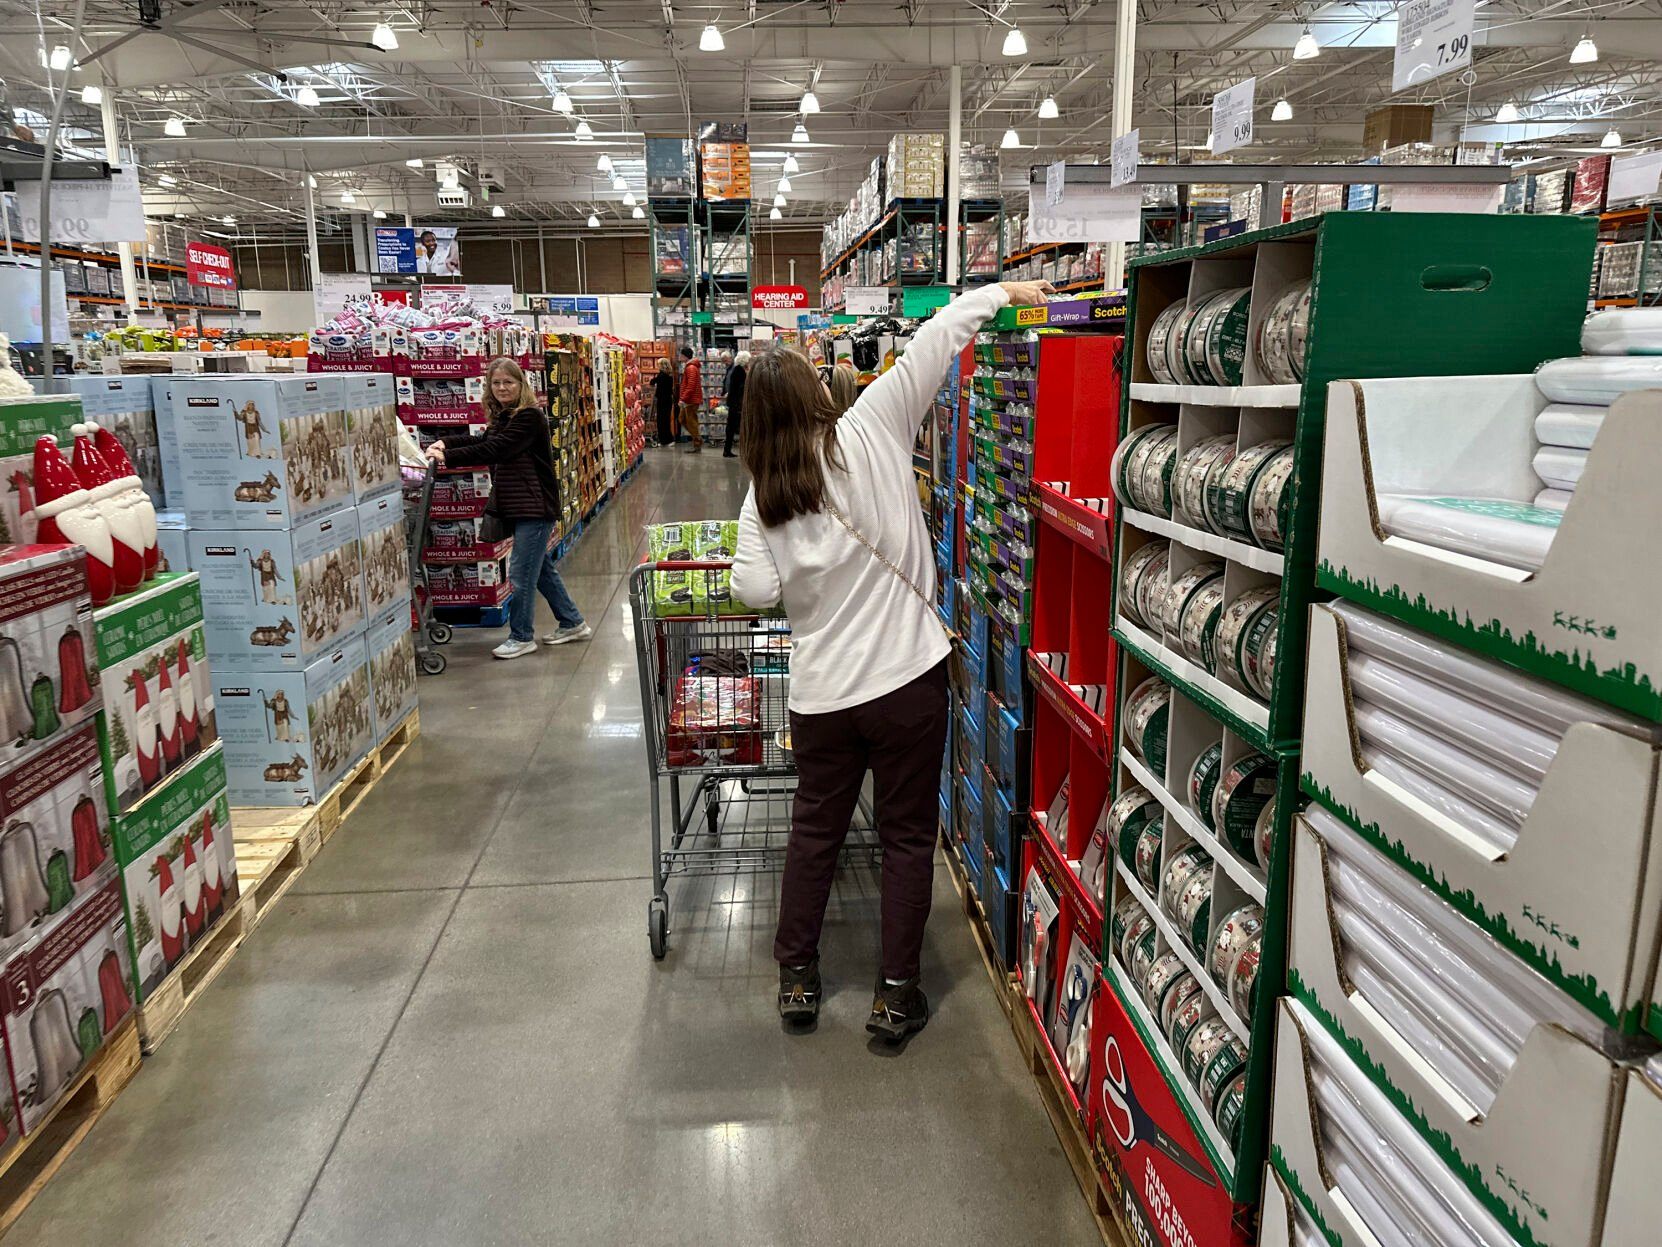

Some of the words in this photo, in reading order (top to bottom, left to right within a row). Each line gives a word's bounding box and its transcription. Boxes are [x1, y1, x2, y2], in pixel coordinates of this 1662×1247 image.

[1437, 34, 1468, 66] 7.99
[1234, 121, 1251, 143] 9.99
[189, 249, 202, 264] SELF
[345, 294, 371, 303] 24.99
[763, 300, 795, 308] CENTER
[493, 303, 512, 312] 5.99
[869, 305, 888, 314] 9.49
[1019, 310, 1034, 321] 65%
[1050, 312, 1080, 323] Gift-Wrap
[16, 980, 30, 1006] 3
[1096, 1132, 1122, 1198] Scotch
[1145, 1157, 1171, 1208] SHARP
[1172, 1204, 1197, 1247] BEYO
